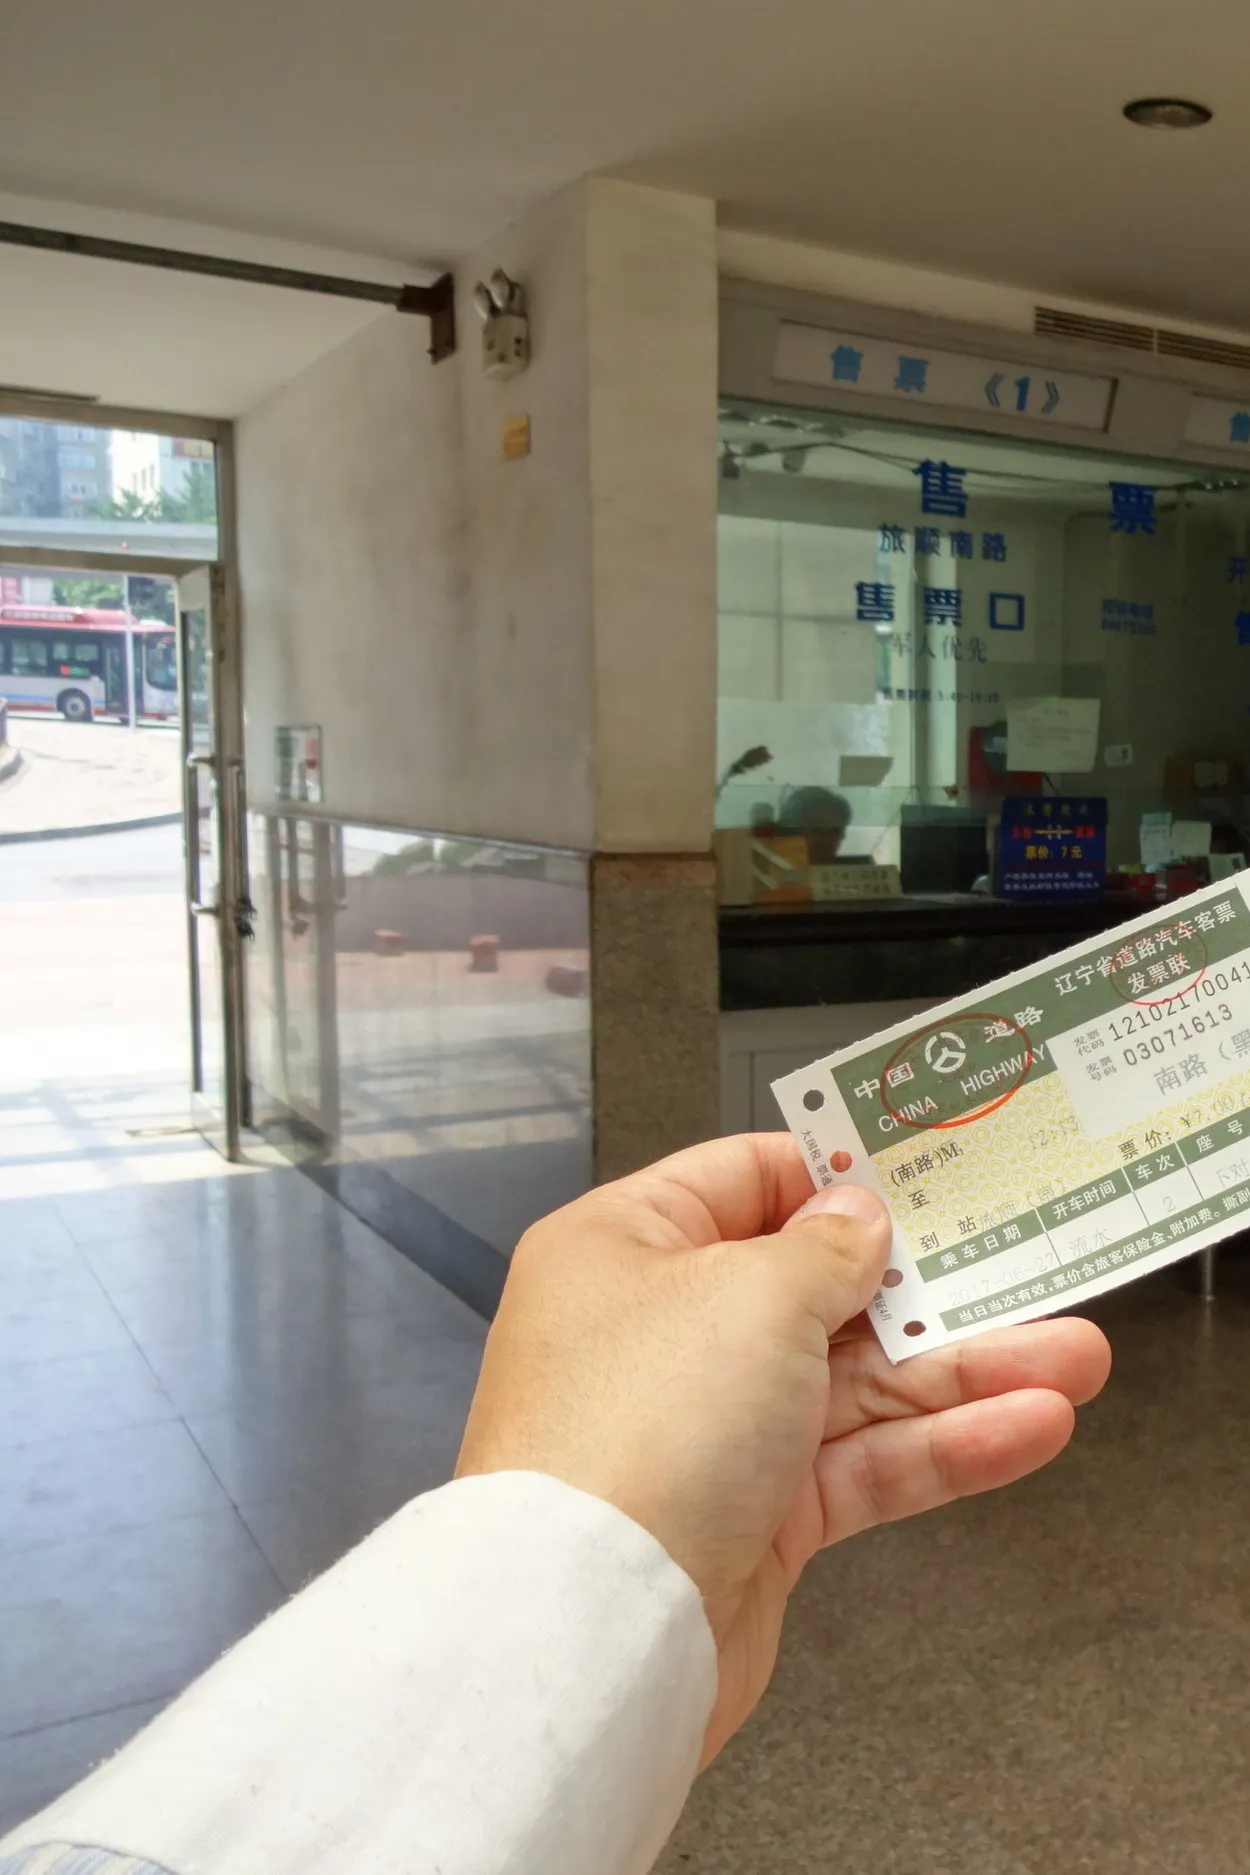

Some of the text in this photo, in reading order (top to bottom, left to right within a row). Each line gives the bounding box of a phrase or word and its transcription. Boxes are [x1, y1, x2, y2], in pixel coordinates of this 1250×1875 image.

[829, 344, 930, 394] 售票
[879, 524, 1006, 562] 旅顺南路
[855, 582, 1025, 630] 售票口
[1054, 901, 1235, 995] 辽宁省道路汽车客票
[1126, 952, 1190, 993] 发票联
[1122, 1004, 1233, 1065] 03071613
[853, 1062, 914, 1101] 中国
[877, 1044, 1048, 1131] CHINA HIGHWAY
[1195, 1119, 1244, 1151] 座号
[1134, 1152, 1174, 1181] 车次
[910, 1188, 930, 1208] 至
[1052, 1181, 1115, 1217] 开车时间
[1161, 1195, 1176, 1212] 2
[919, 1216, 976, 1251] 到站
[941, 1224, 1021, 1268] 乘车日期
[949, 1250, 1055, 1306] 2017-06-27
